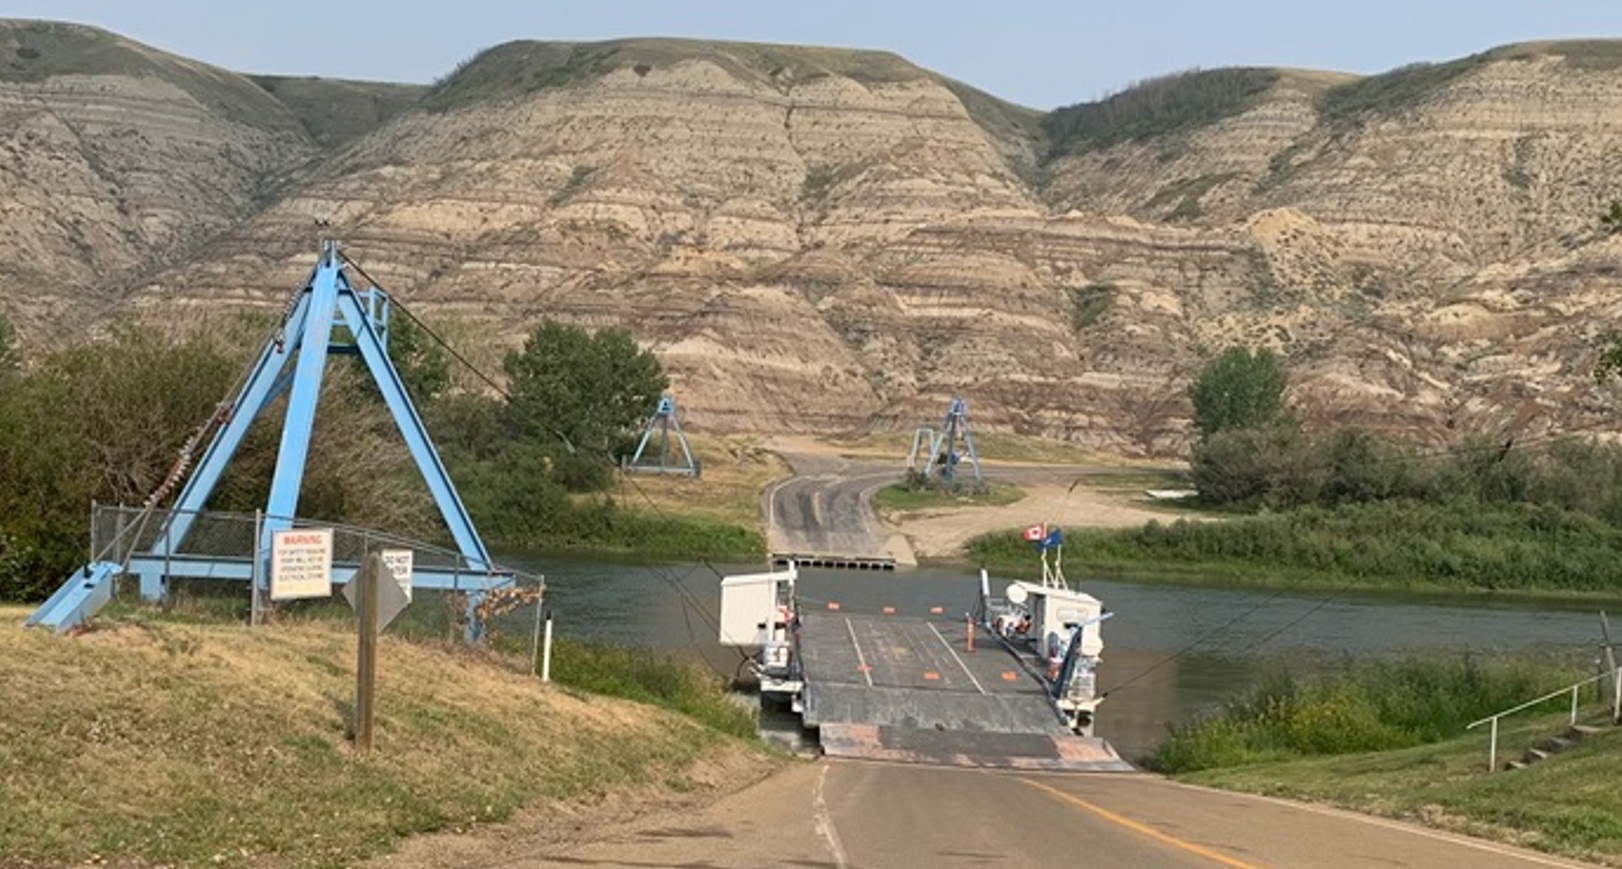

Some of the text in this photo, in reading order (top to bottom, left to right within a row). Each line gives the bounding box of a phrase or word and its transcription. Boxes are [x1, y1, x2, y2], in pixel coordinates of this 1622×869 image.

[284, 535, 323, 545] WARNING
[385, 556, 410, 565] DO NOT
